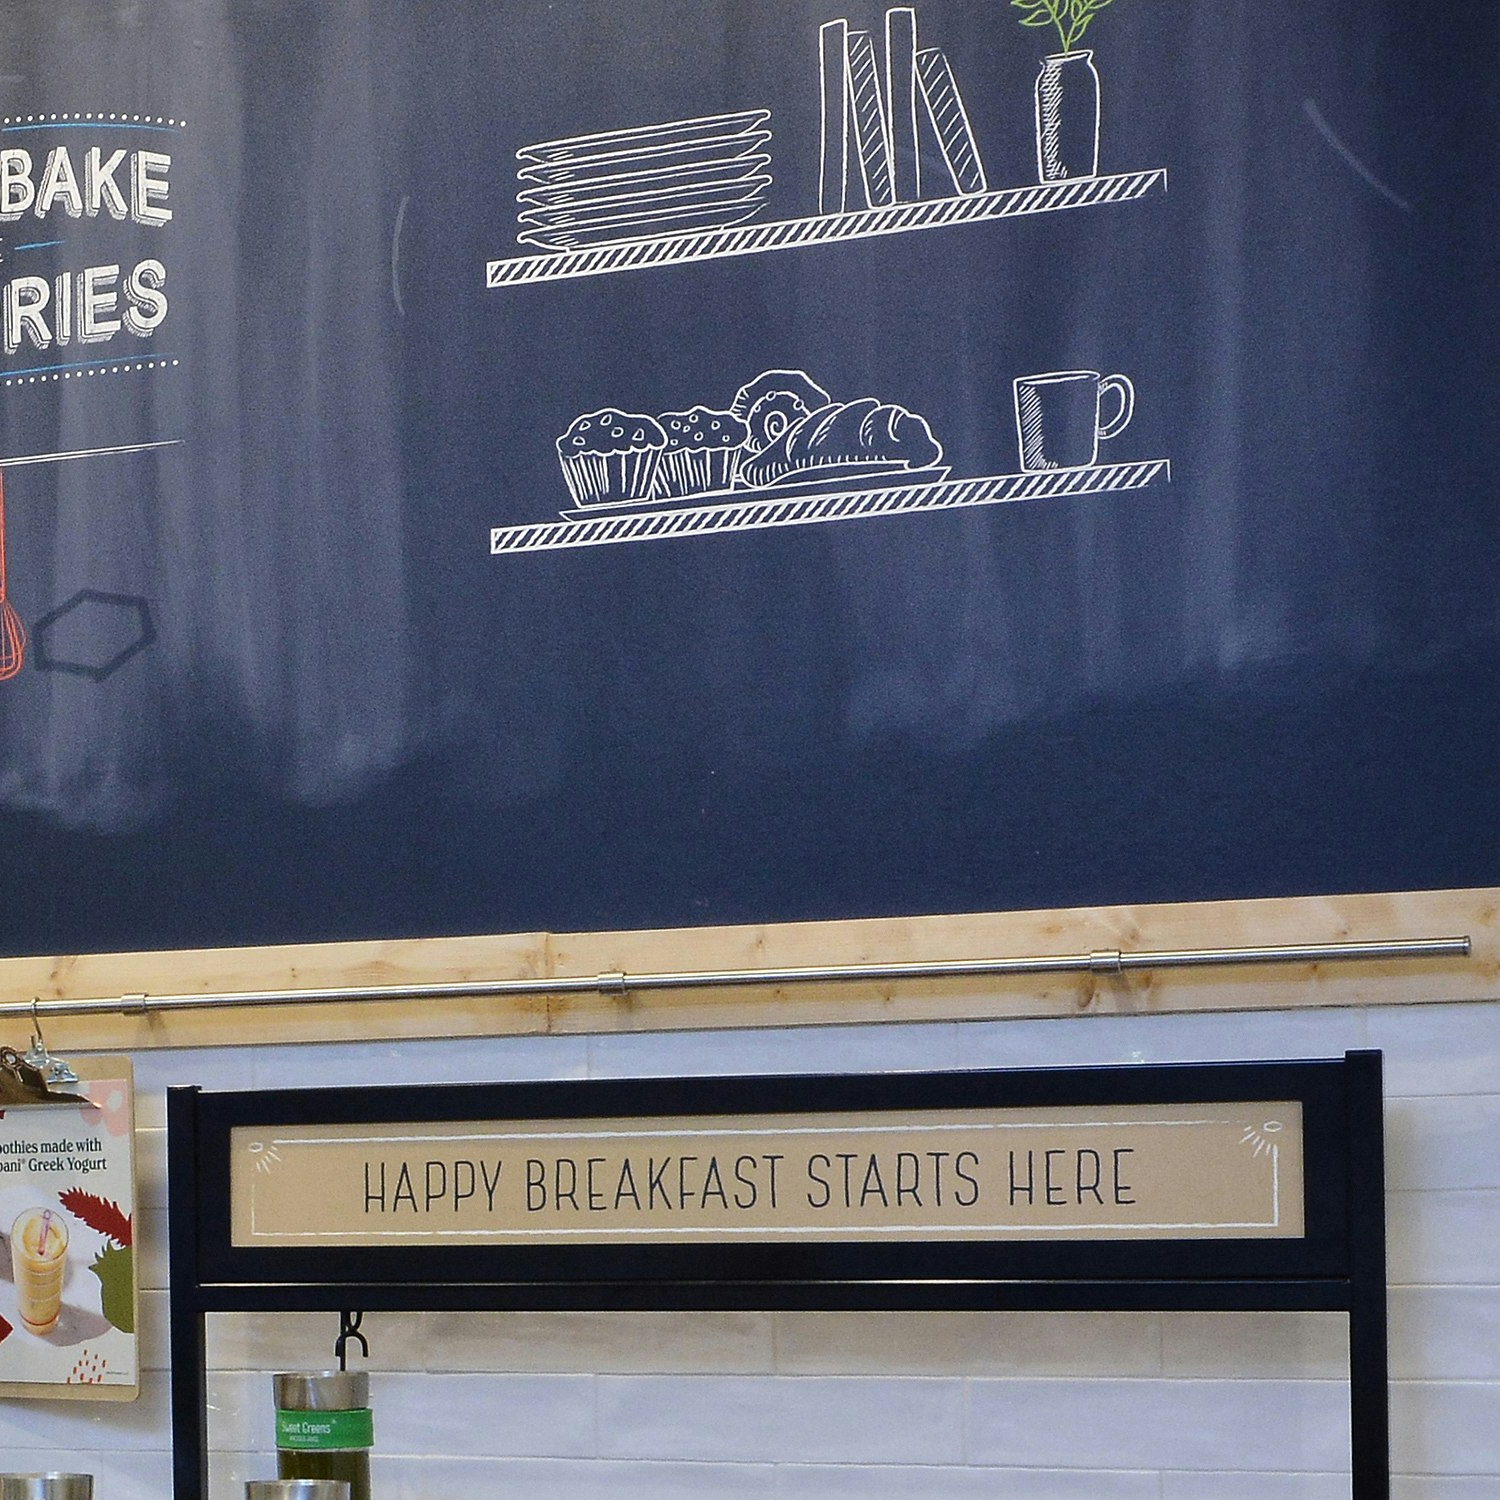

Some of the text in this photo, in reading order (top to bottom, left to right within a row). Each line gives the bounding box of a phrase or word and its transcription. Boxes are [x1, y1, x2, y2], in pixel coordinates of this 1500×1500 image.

[40, 1139, 73, 1153] made
[76, 1138, 102, 1152] with
[28, 1157, 64, 1171] Greek
[67, 1157, 107, 1174] Yogurt
[364, 1149, 1136, 1214] HAPPY BREAKFAST STARTS HERE
[302, 1421, 331, 1434] Greens
